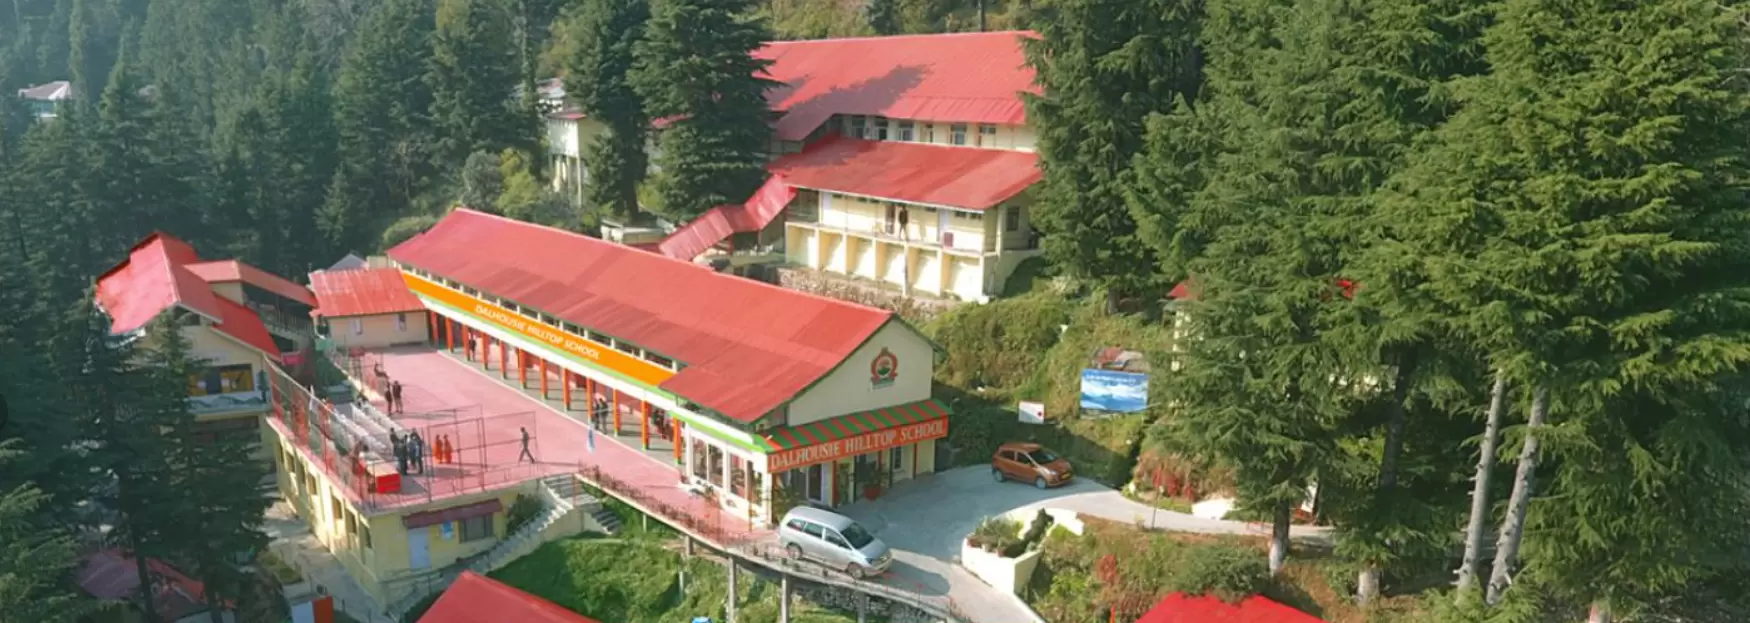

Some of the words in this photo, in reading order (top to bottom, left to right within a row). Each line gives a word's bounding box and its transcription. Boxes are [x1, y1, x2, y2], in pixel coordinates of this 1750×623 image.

[475, 303, 525, 331] DALHOUSIE
[528, 325, 564, 344] HILLTOP
[565, 340, 600, 359] SCHOOL
[770, 443, 841, 469] DALHOUSIE
[845, 429, 897, 453] HILLTOP
[900, 419, 945, 440] SCHOOL
